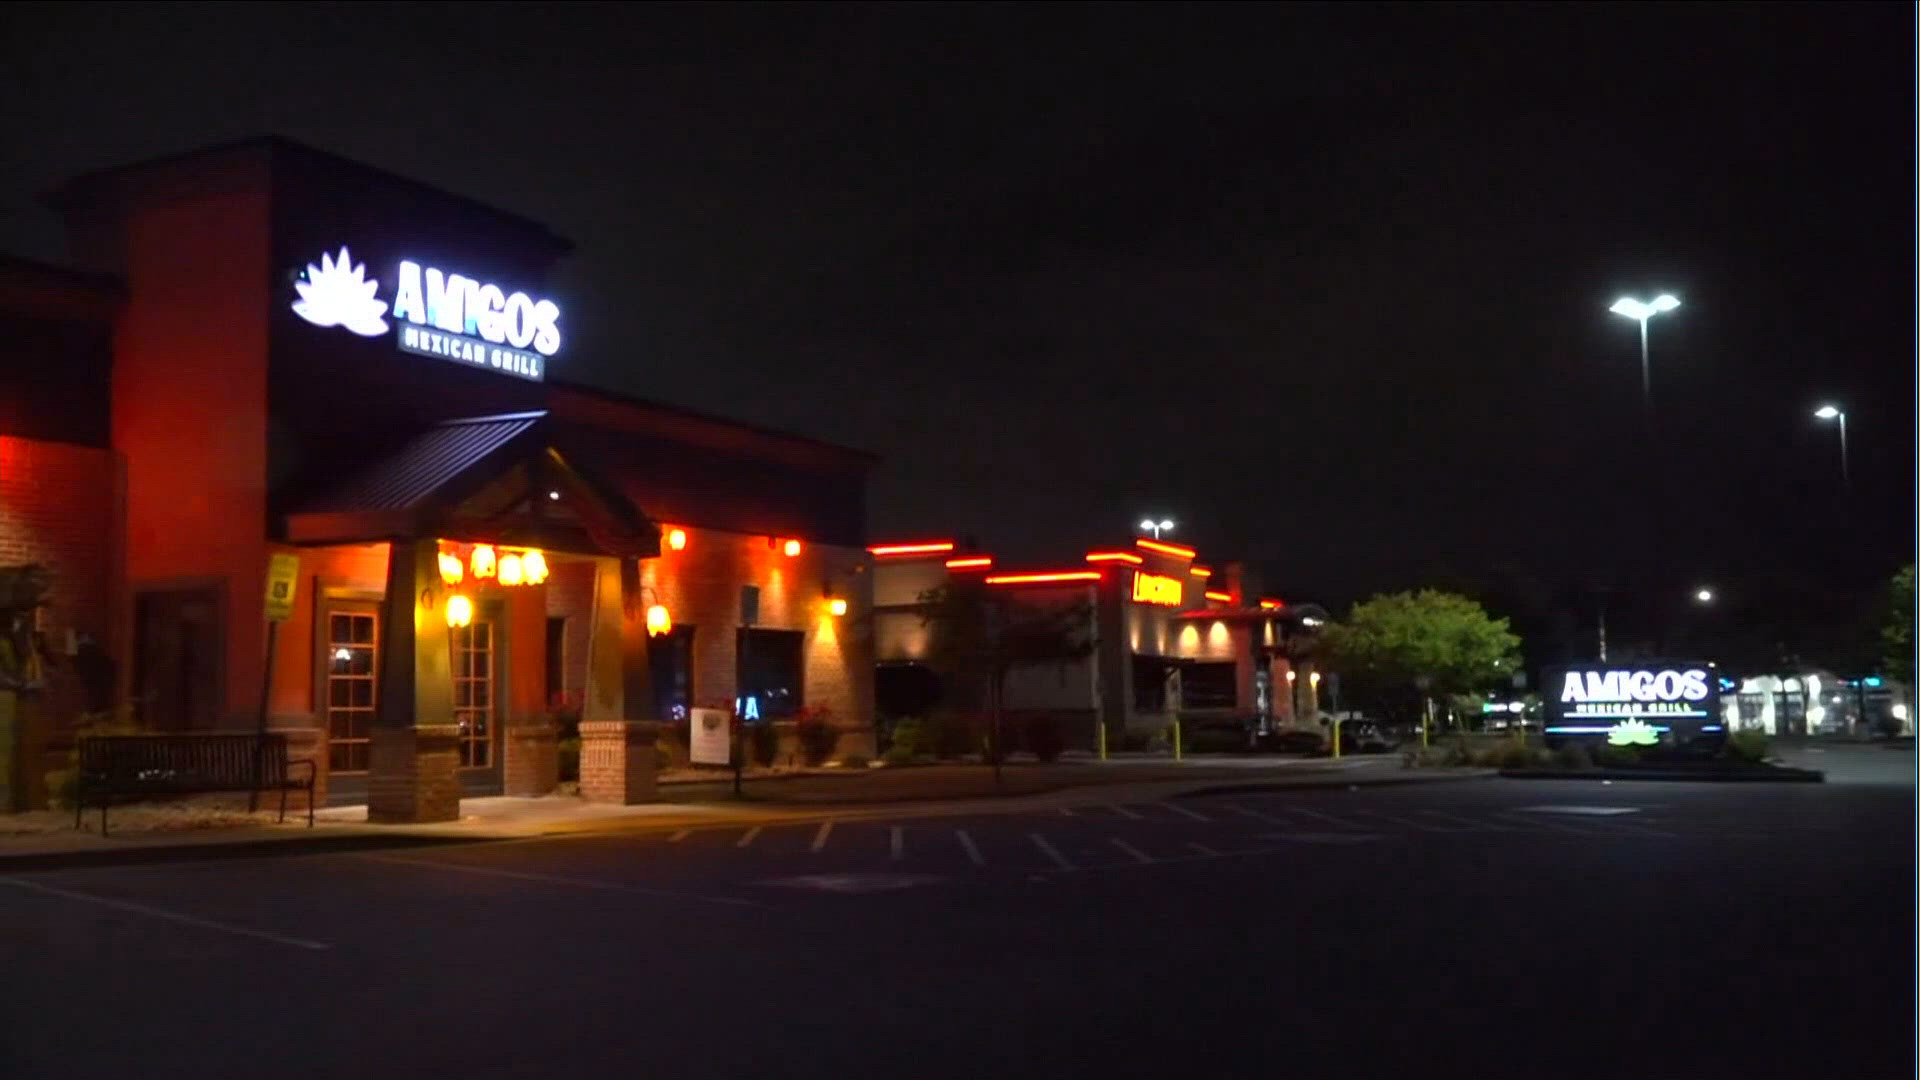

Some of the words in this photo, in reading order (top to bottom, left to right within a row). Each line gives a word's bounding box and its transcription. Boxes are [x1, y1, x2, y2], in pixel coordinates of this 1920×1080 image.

[393, 260, 560, 356] AMIGOS
[405, 327, 485, 364] MEXICAN
[491, 349, 539, 377] GRILL
[1561, 669, 1708, 702] AMIGOS
